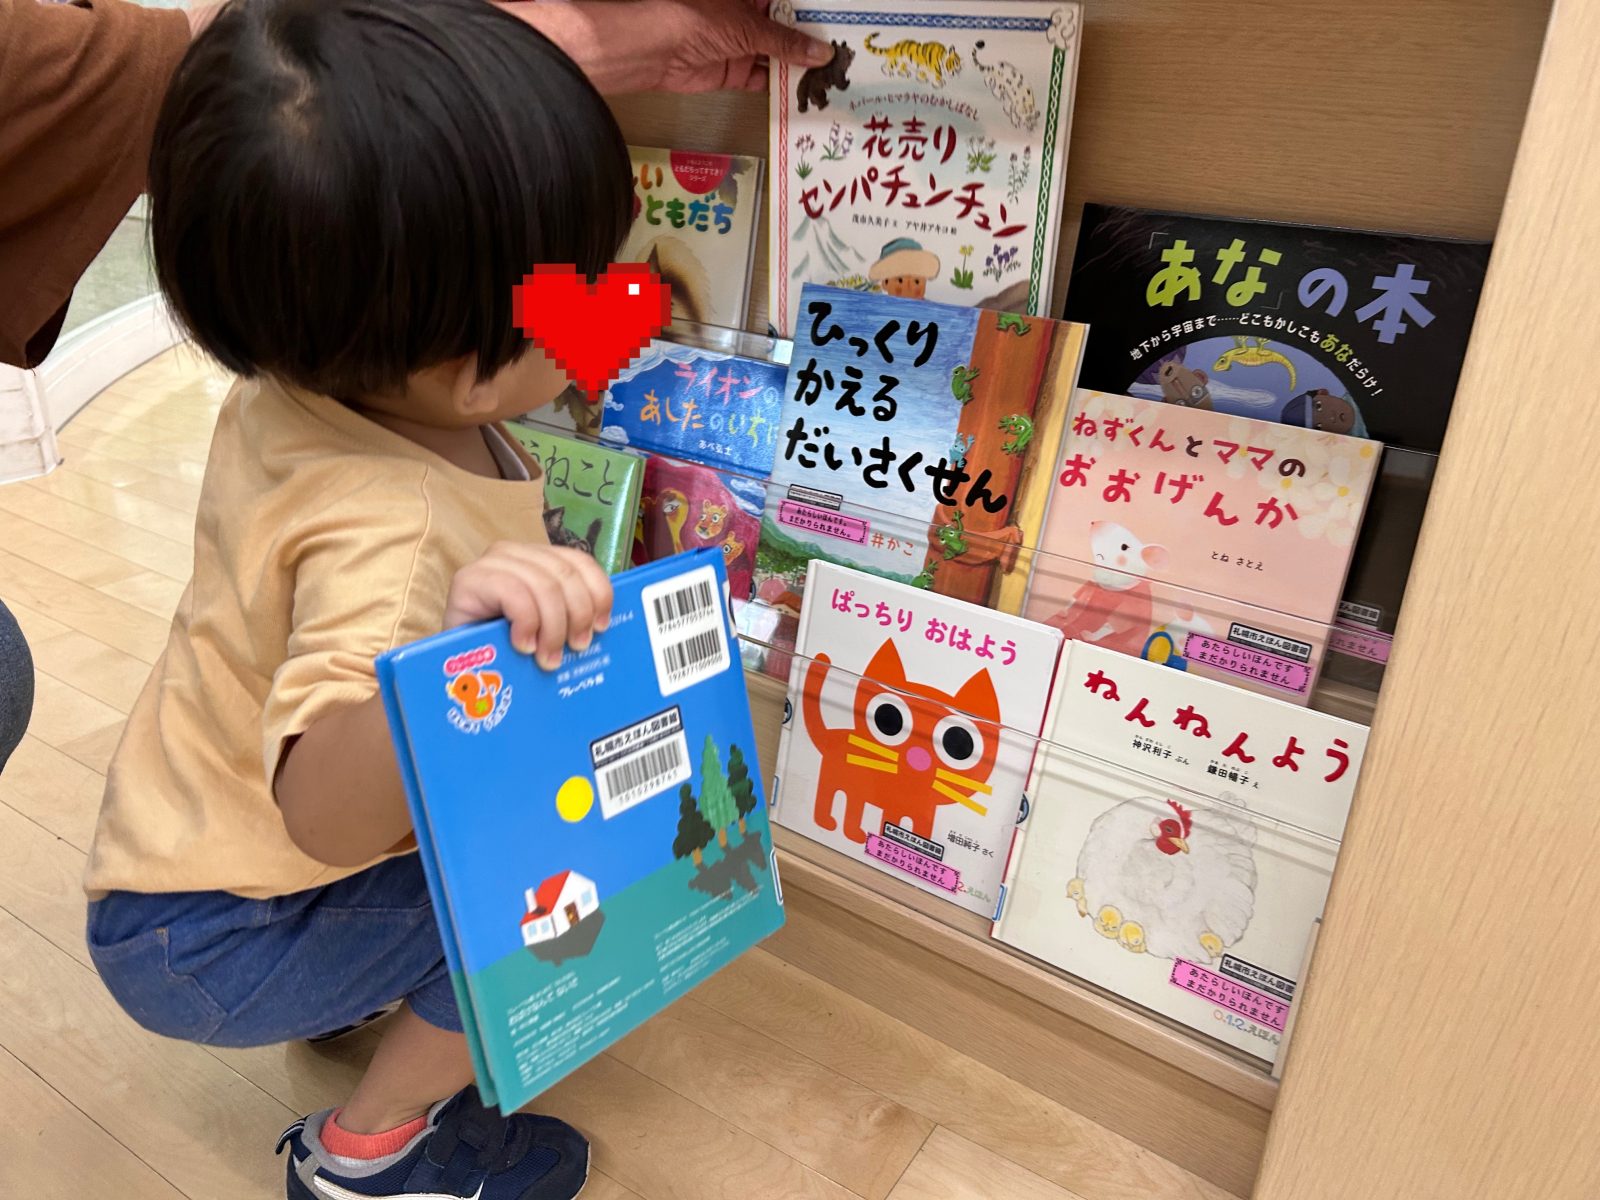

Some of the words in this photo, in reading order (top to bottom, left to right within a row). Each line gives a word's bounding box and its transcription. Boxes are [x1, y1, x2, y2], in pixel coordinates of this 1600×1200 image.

[862, 114, 957, 165] 花売り
[633, 163, 663, 190] い
[632, 192, 734, 235] ともだち
[799, 165, 1027, 239] センパチュンチュン
[808, 302, 939, 367] ひっくり
[675, 362, 779, 406] ライオンの
[794, 358, 900, 421] かえる
[785, 418, 1008, 513] だいさくせん
[1072, 412, 1306, 478] ねずくんとママの
[1059, 454, 1298, 529] おおげんか
[1211, 551, 1229, 563] とね
[1235, 557, 1264, 571] さとえ
[831, 588, 913, 632] ぱっちり
[924, 618, 1017, 666] おはよう
[1233, 627, 1308, 655] 札幌市えほん図書館
[1199, 651, 1290, 685] まだかりられません
[1201, 640, 1293, 672] あたらしいほんです
[1083, 670, 1349, 783] ねんねんよう
[1132, 739, 1172, 759] 神沢利子
[877, 850, 945, 885] まだかりられません
[878, 840, 946, 875] あたらしいほんです
[982, 848, 994, 858] さく
[1187, 980, 1281, 1026] まだかりられません
[1189, 968, 1286, 1013] あたらしいほんです
